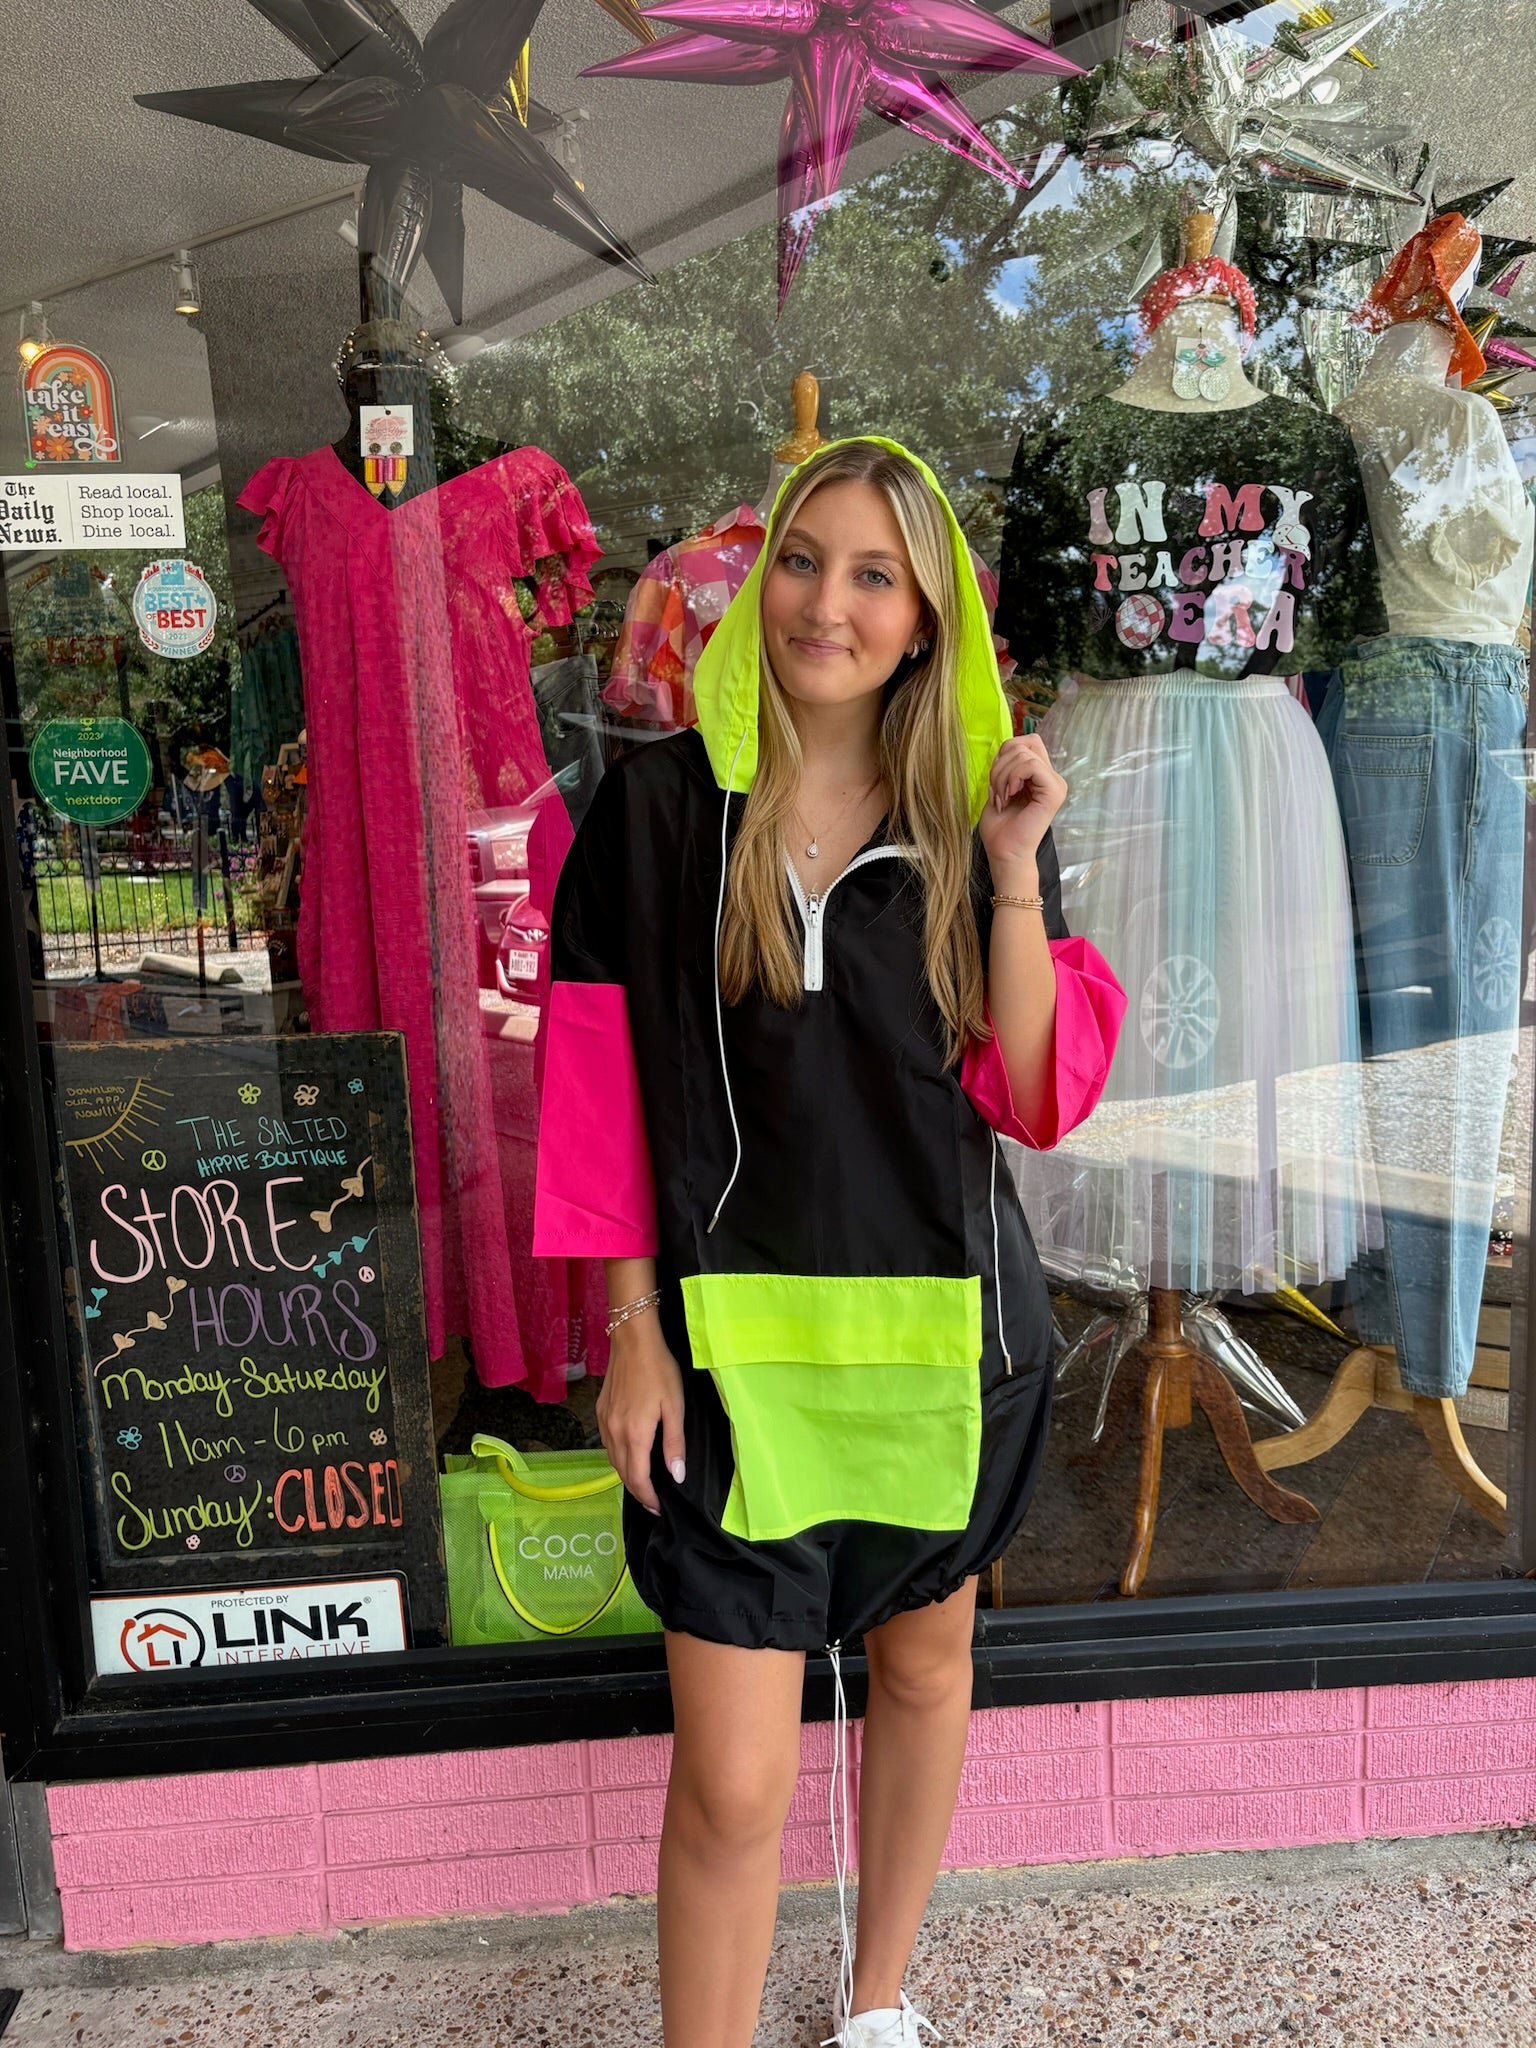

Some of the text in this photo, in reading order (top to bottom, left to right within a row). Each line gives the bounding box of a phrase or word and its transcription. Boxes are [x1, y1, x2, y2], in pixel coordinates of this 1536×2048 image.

[26, 380, 85, 411] take
[63, 404, 81, 422] it
[48, 423, 117, 453] easy
[4, 482, 36, 499] The
[78, 485, 172, 499] Read local.
[81, 504, 174, 520] Shop local.
[1086, 481, 1314, 545] IN MY
[0, 523, 63, 544] News.
[83, 524, 175, 538] Dine local.
[1089, 539, 1306, 593] TEACHER
[144, 592, 194, 612] BEST
[146, 609, 207, 628] OF BEST
[1168, 583, 1296, 653] ERA
[160, 644, 199, 656] WINNER
[78, 731, 101, 741] 2023
[53, 747, 128, 759] Neighborhood
[53, 759, 129, 786] FAVE
[65, 794, 123, 806] nextdoor
[64, 1095, 120, 1107] OUR APP
[176, 1115, 348, 1151] THE SALTED
[196, 1149, 348, 1177] HIPPIE BOUTIQUE
[188, 1279, 378, 1362] HOURS
[274, 1458, 403, 1533] CLOSED
[518, 1531, 618, 1560] COCO
[543, 1563, 596, 1581] MAMA
[211, 1594, 289, 1608] PROTECTED BY
[212, 1601, 370, 1649] LINK
